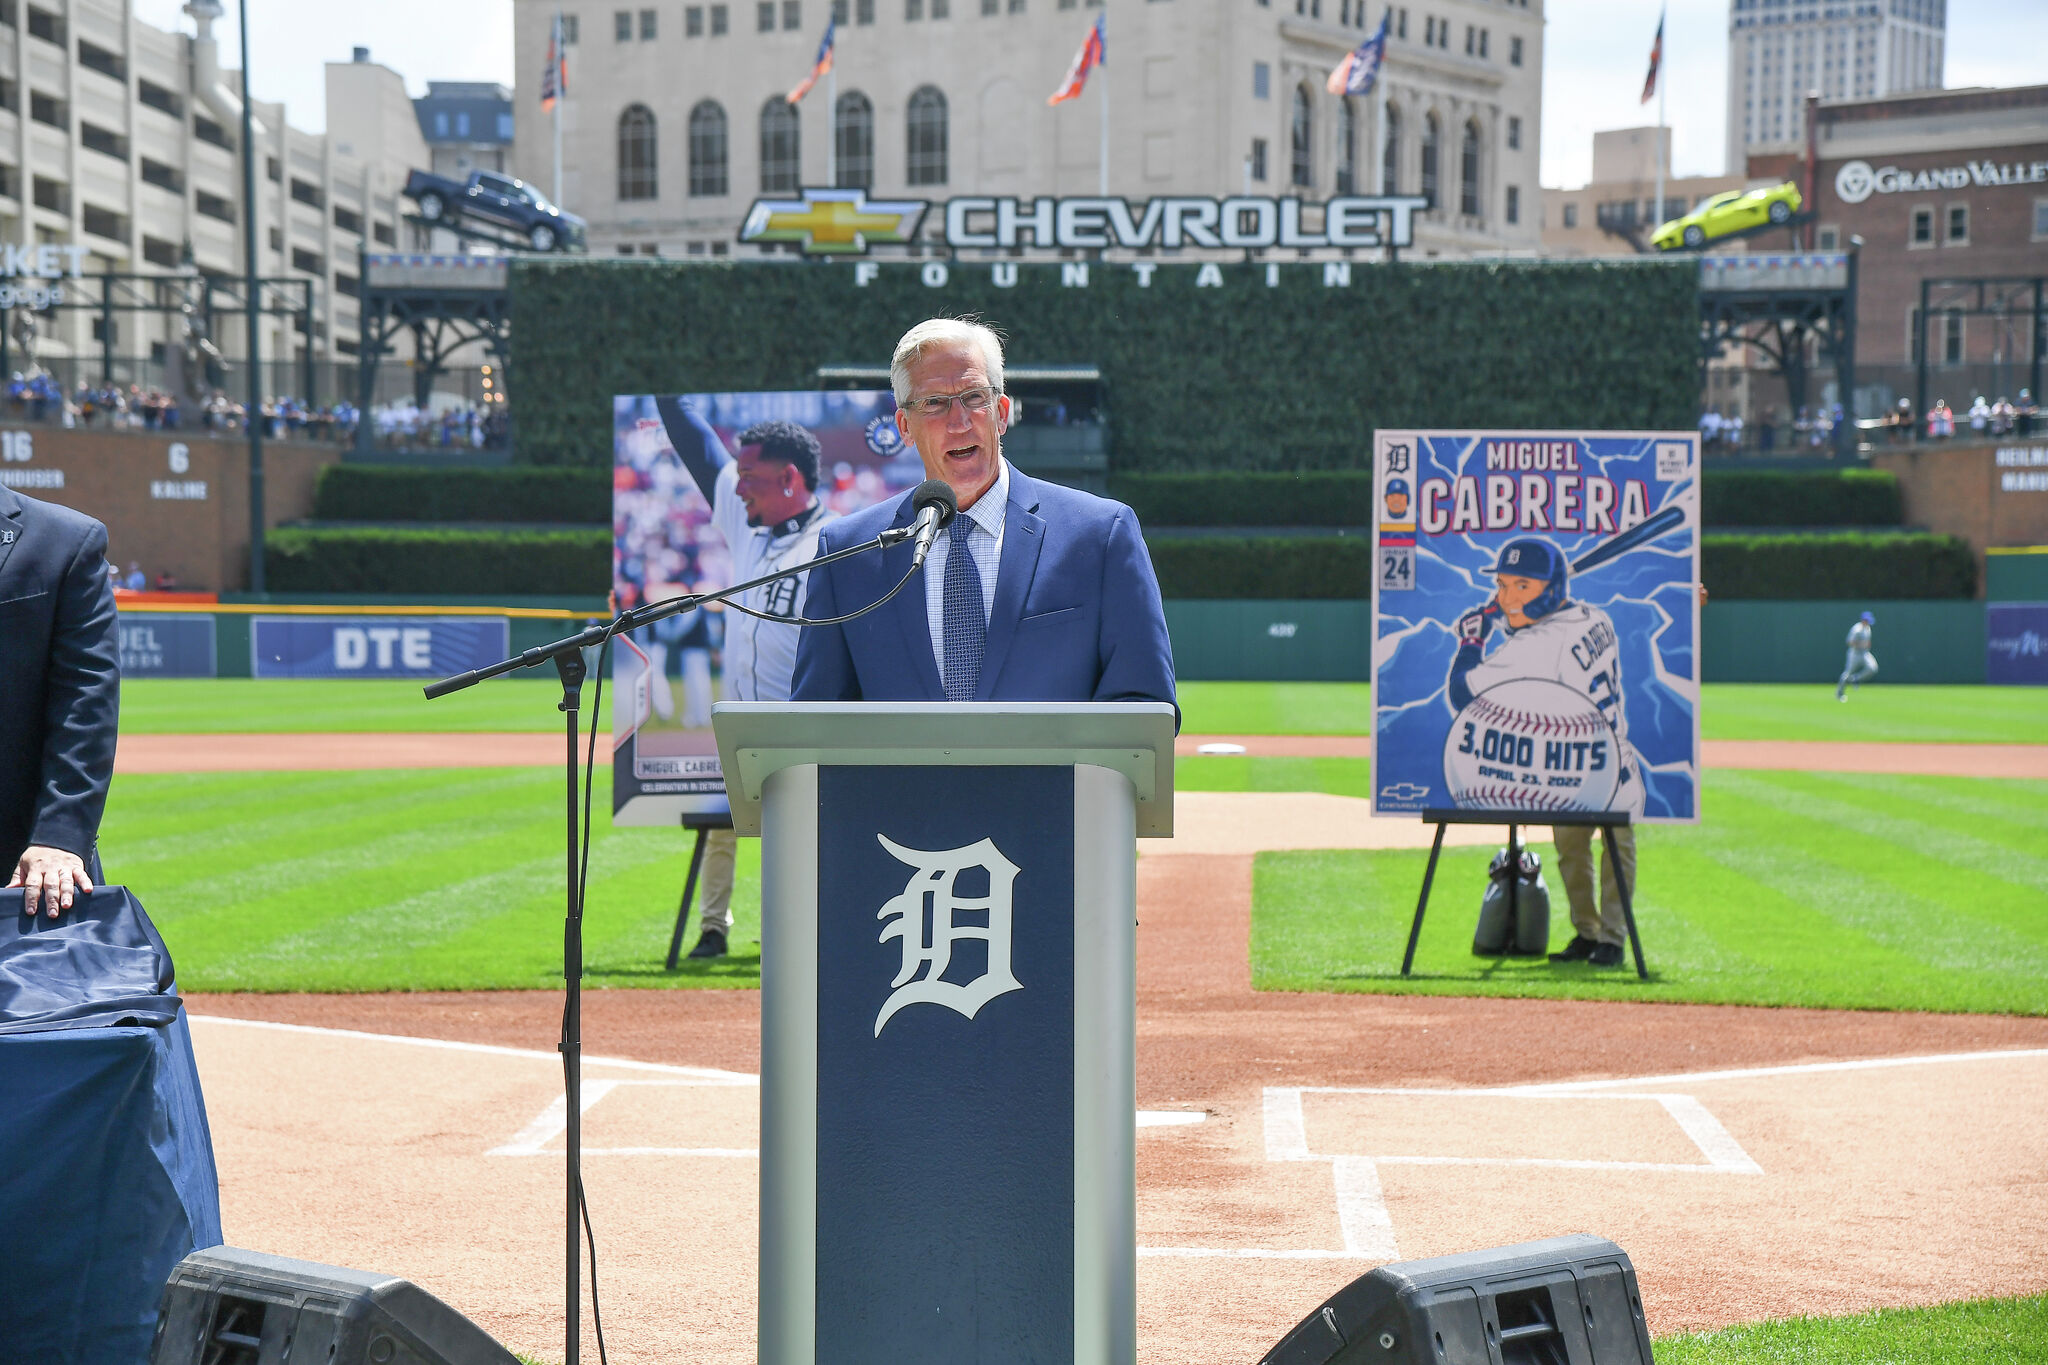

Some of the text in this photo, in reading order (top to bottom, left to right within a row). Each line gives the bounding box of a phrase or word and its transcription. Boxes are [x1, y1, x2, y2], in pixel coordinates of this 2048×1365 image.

[947, 197, 1428, 248] CHEVROLET
[0, 244, 91, 278] KET
[855, 262, 1352, 288] FOUNTAIN
[2, 431, 33, 462] 16
[168, 442, 189, 474] 6
[1487, 442, 1581, 472] MIGUEL
[151, 481, 207, 500] KALINE
[1420, 474, 1650, 535] CABRERA
[1385, 556, 1411, 580] 24
[333, 629, 431, 670] DTE
[1458, 721, 1608, 772] 3,000 HITS
[1479, 764, 1516, 783] APRIL
[874, 832, 1025, 1040] D
